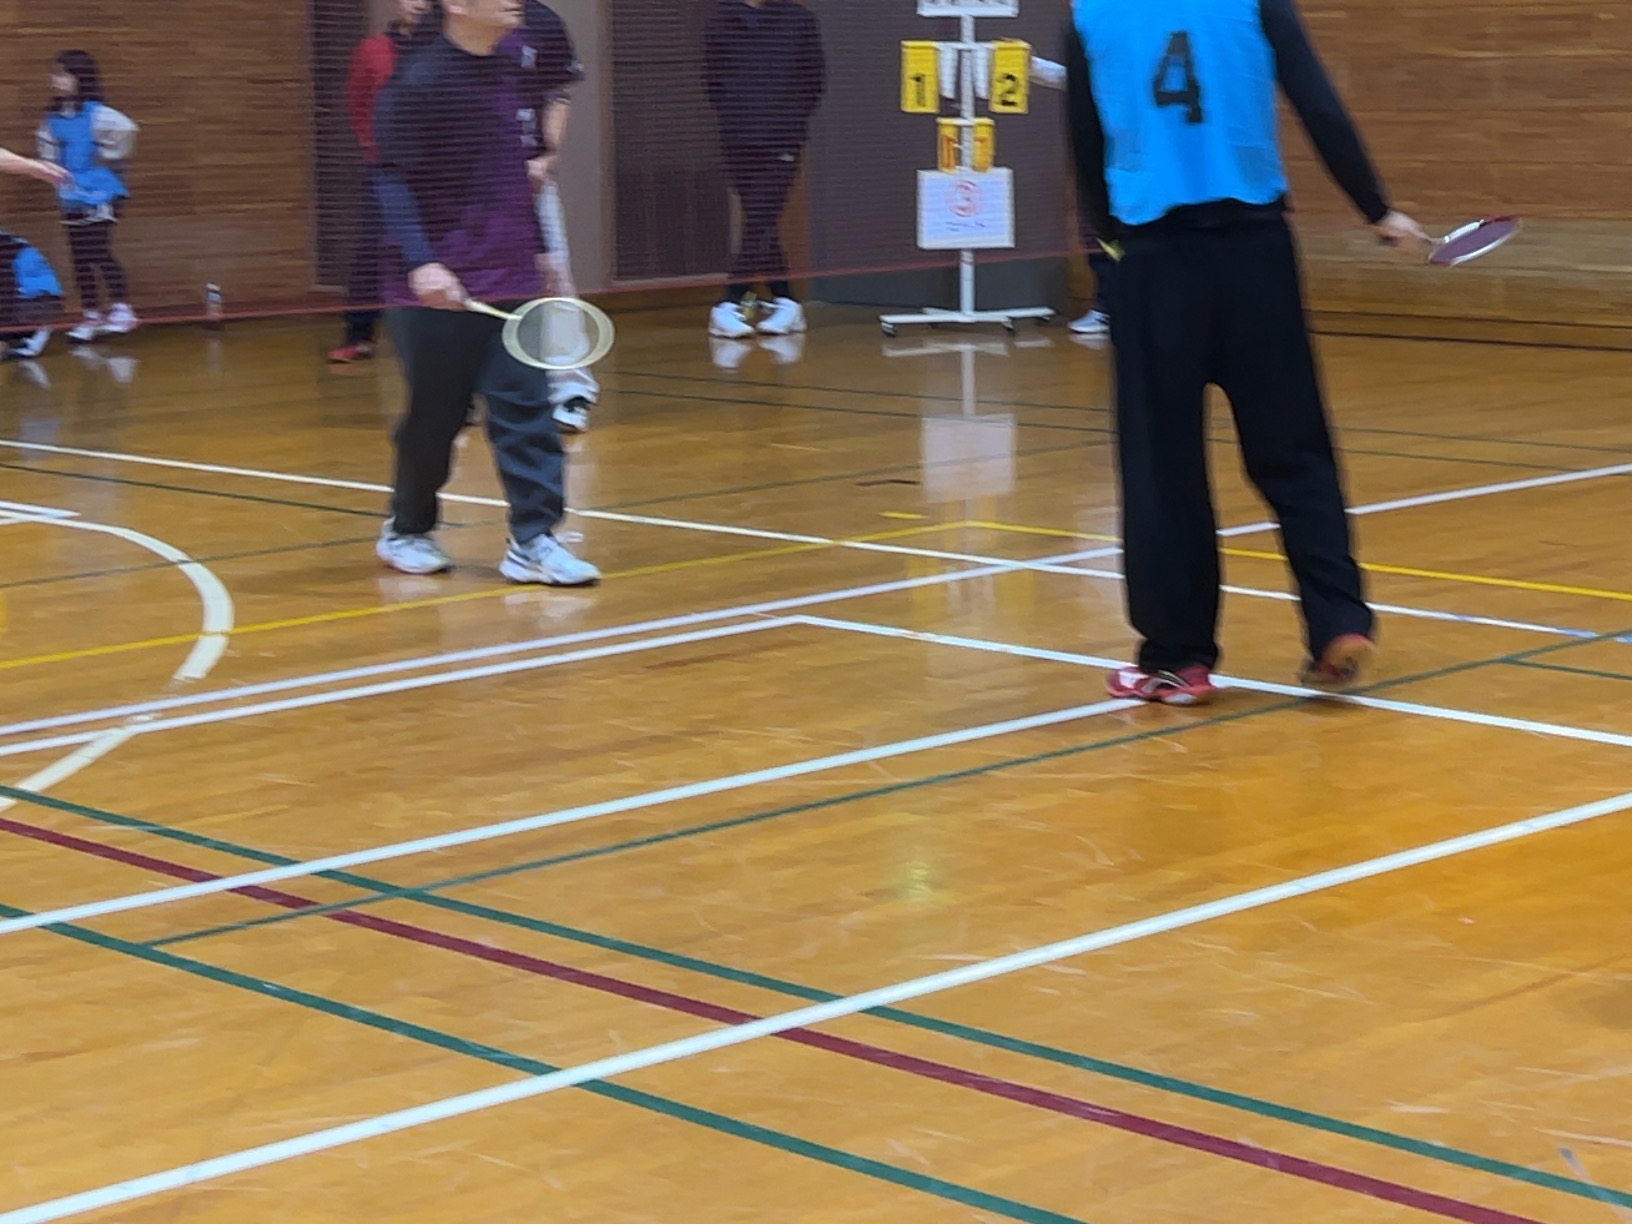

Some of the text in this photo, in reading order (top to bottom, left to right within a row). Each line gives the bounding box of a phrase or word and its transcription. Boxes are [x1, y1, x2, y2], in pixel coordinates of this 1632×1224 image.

[909, 72, 926, 108] 1
[997, 72, 1018, 107] 2
[1152, 30, 1204, 124] 4
